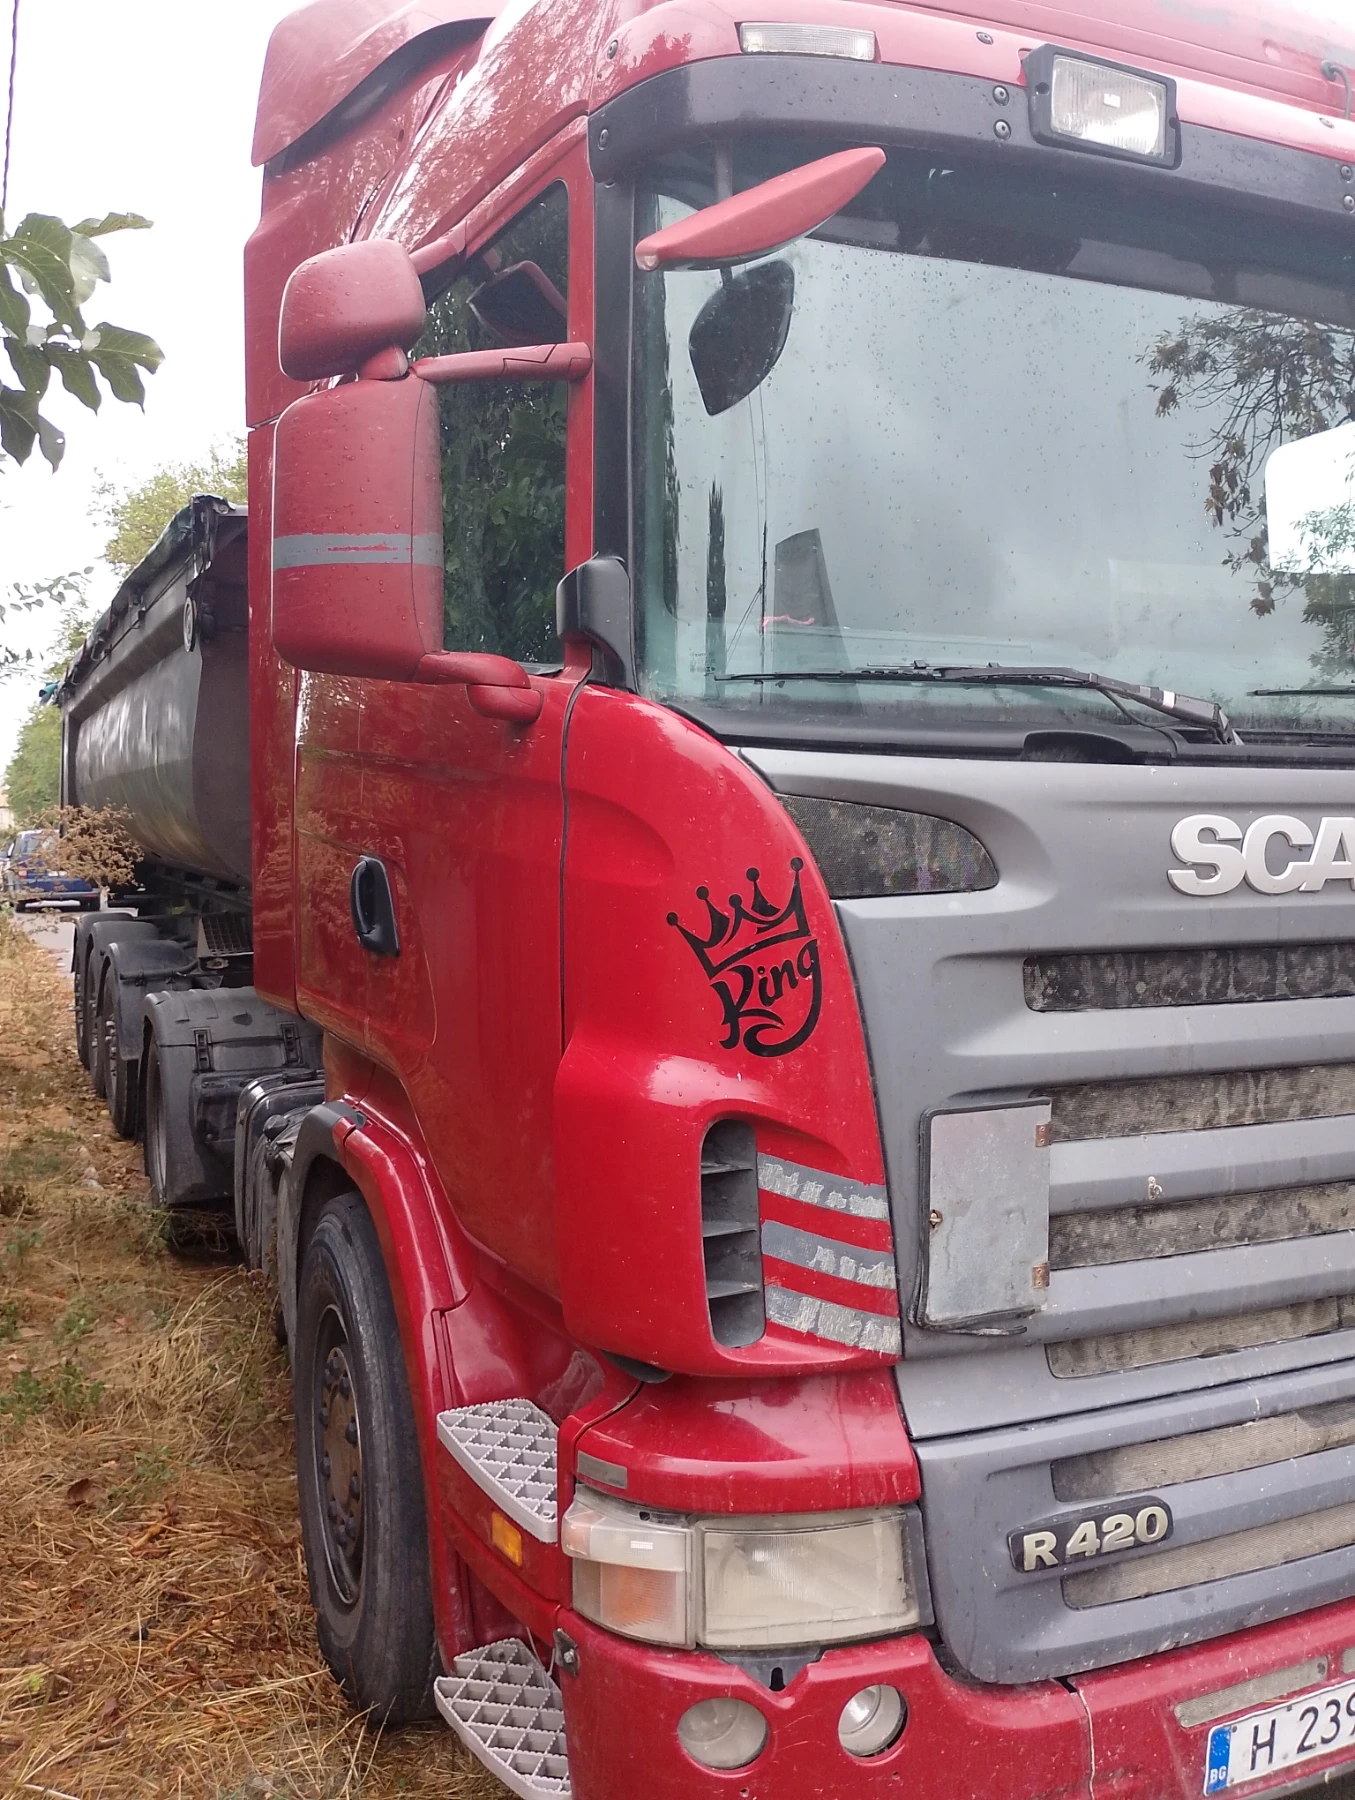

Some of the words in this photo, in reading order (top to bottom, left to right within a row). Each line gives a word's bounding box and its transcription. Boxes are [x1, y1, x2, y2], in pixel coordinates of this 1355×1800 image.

[1167, 814, 1355, 896] SCA
[710, 938, 822, 1058] King
[1023, 1531, 1058, 1571] R
[1066, 1506, 1168, 1557] 420
[1209, 1765, 1227, 1783] BG
[1250, 1717, 1276, 1771] H
